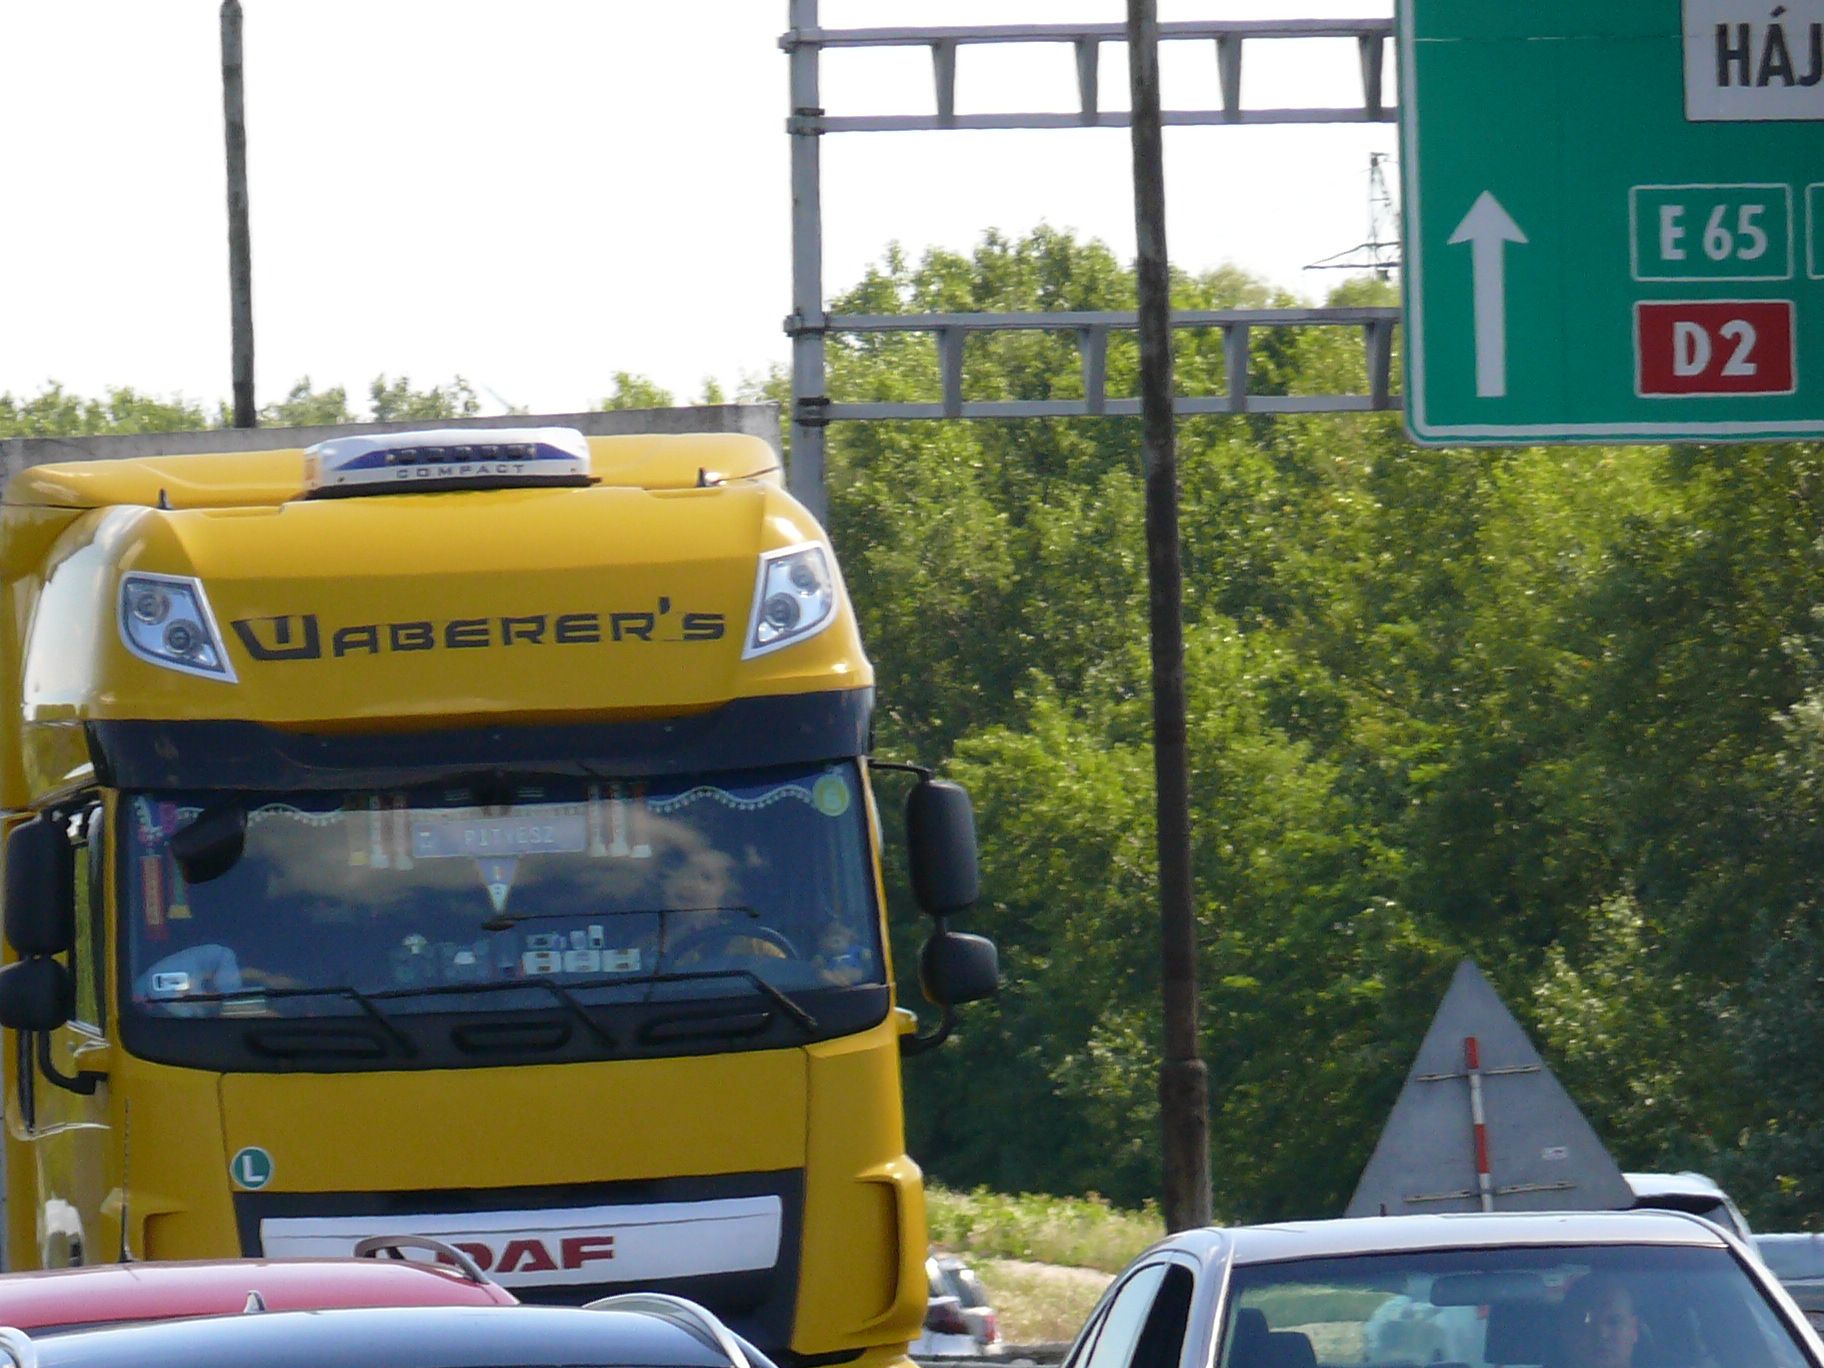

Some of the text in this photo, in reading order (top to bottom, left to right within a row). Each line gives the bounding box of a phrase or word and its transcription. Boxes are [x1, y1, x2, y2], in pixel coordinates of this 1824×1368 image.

[1659, 204, 1769, 261] E 65
[1672, 319, 1758, 377] D2
[396, 463, 525, 479] COMPACT
[230, 596, 726, 662] WABERER'S
[242, 1155, 265, 1183] L
